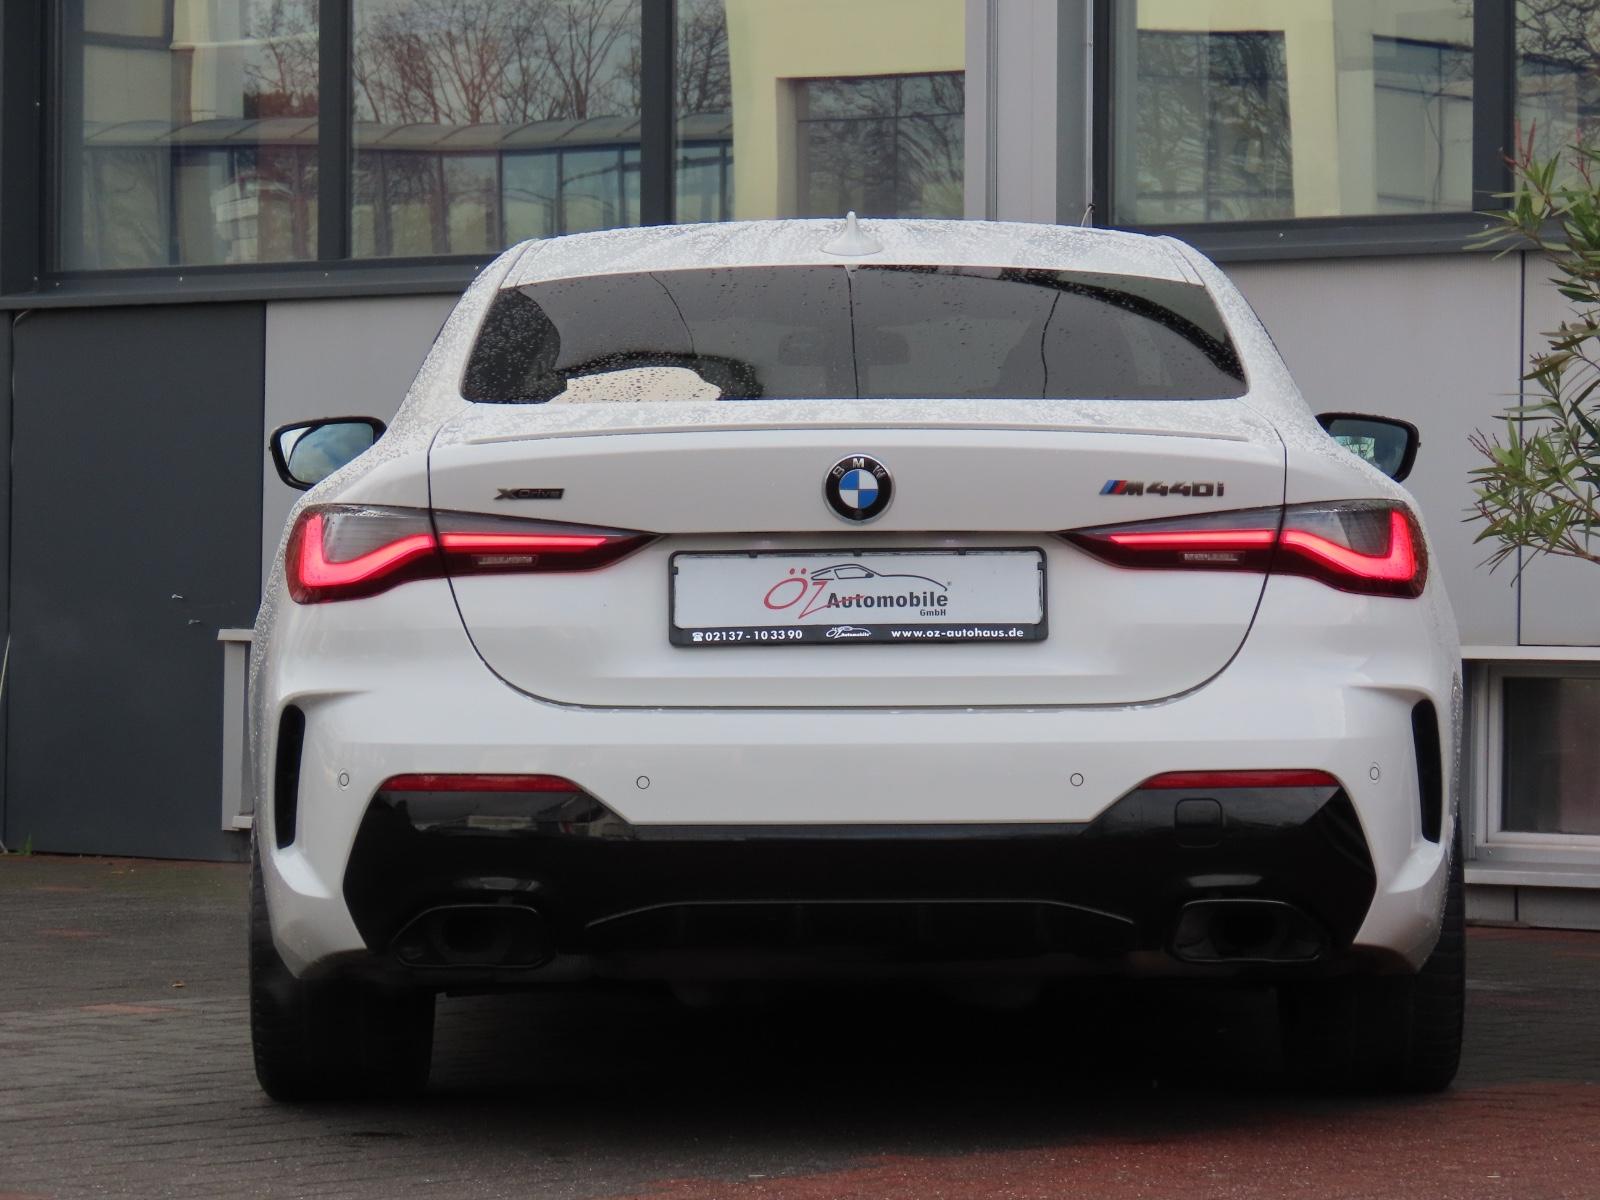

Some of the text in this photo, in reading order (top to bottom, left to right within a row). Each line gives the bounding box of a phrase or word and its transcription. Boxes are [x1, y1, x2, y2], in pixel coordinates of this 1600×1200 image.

[832, 457, 886, 479] BMW
[827, 591, 948, 609] Automobile
[919, 608, 947, 617] GmbH
[891, 627, 1024, 638] www.oz-autohaus.de
